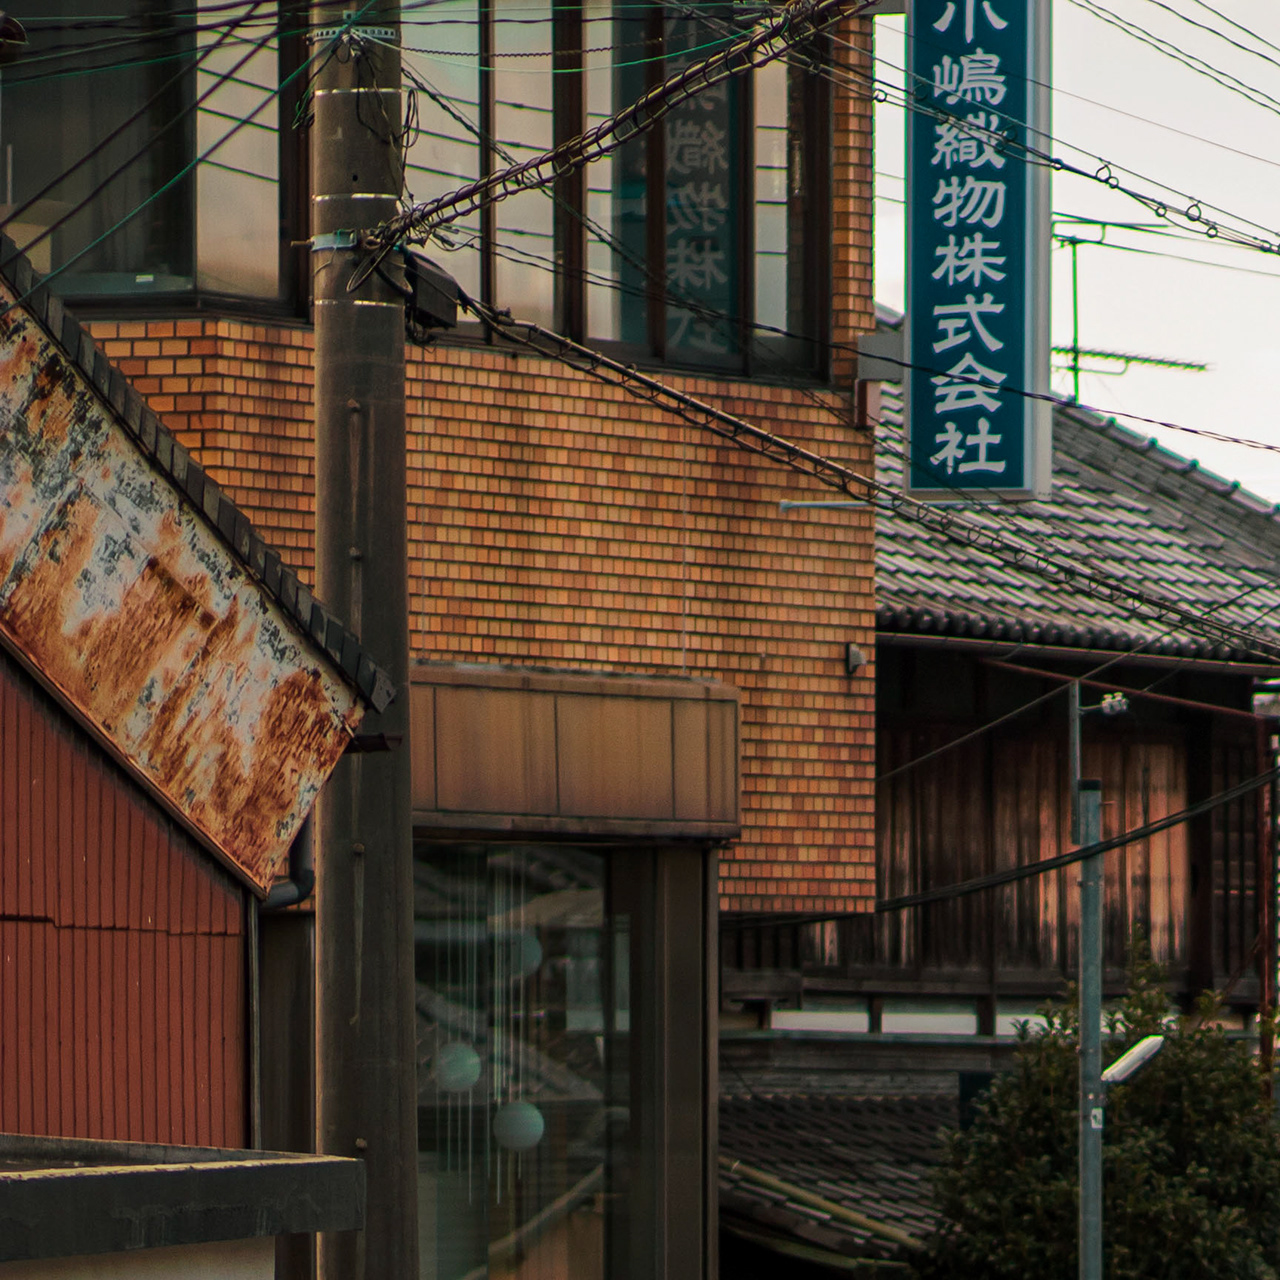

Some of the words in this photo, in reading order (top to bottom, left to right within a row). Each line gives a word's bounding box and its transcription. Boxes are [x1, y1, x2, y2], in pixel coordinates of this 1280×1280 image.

[931, 0, 1007, 475] 小嶋織物株式会社
